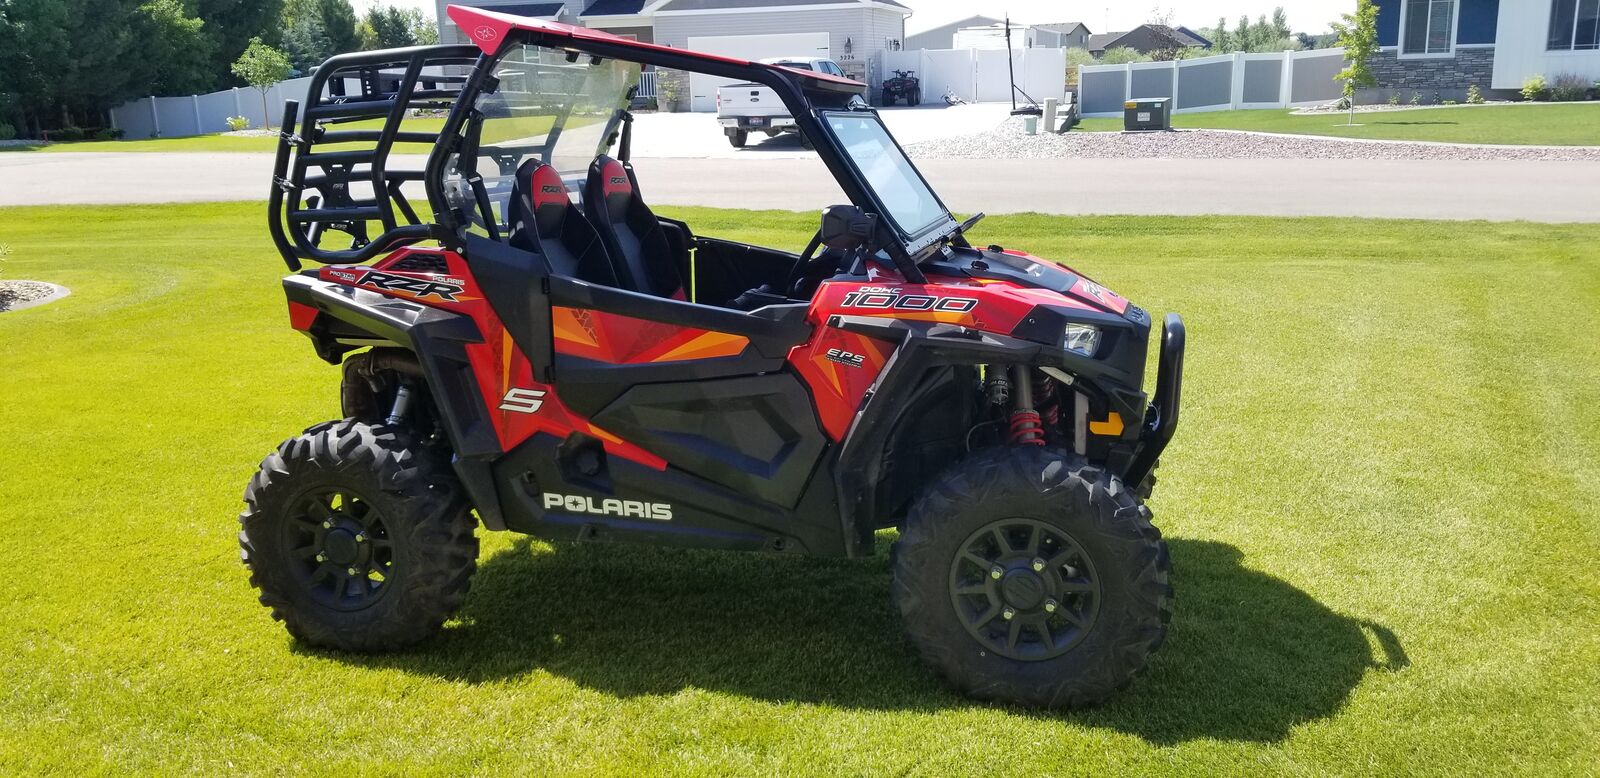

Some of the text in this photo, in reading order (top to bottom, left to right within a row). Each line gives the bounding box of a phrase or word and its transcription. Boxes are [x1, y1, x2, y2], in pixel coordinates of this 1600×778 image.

[541, 185, 562, 193] RZR
[355, 271, 464, 302] RZR
[432, 275, 465, 285] POLARIS
[841, 292, 978, 313] 1000
[827, 348, 866, 363] EPS
[498, 388, 546, 414] S
[543, 492, 673, 520] POLARIS
